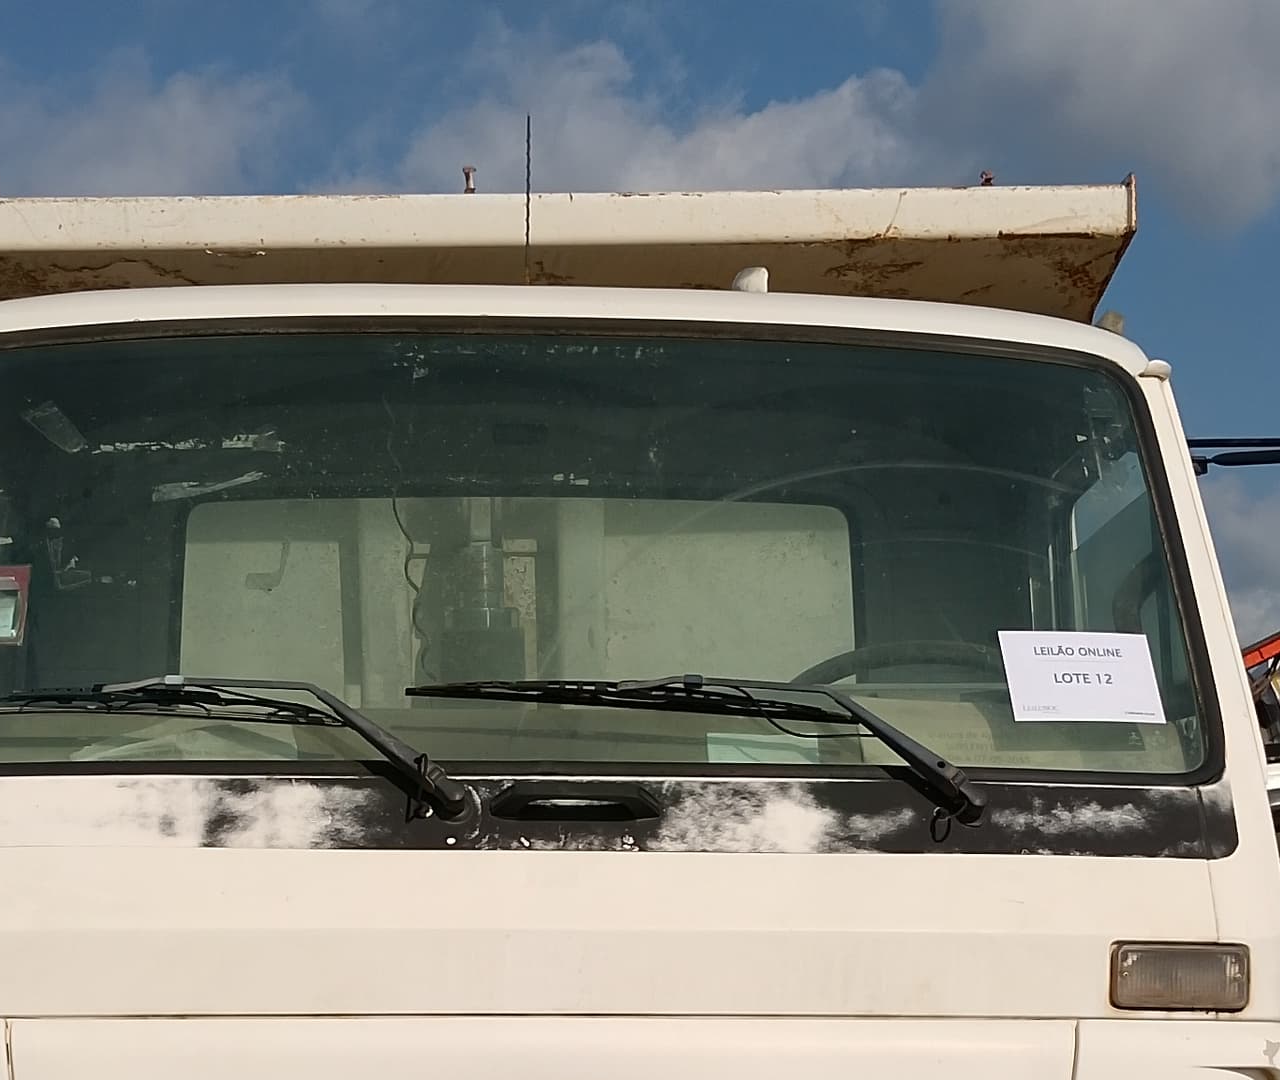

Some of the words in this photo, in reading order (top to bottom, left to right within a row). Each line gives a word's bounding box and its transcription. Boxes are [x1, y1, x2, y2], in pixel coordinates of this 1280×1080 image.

[1033, 645, 1075, 657] LEILÃO
[1078, 647, 1123, 658] ONLINE
[1053, 672, 1092, 684] LOTE
[1095, 673, 1114, 685] 12
